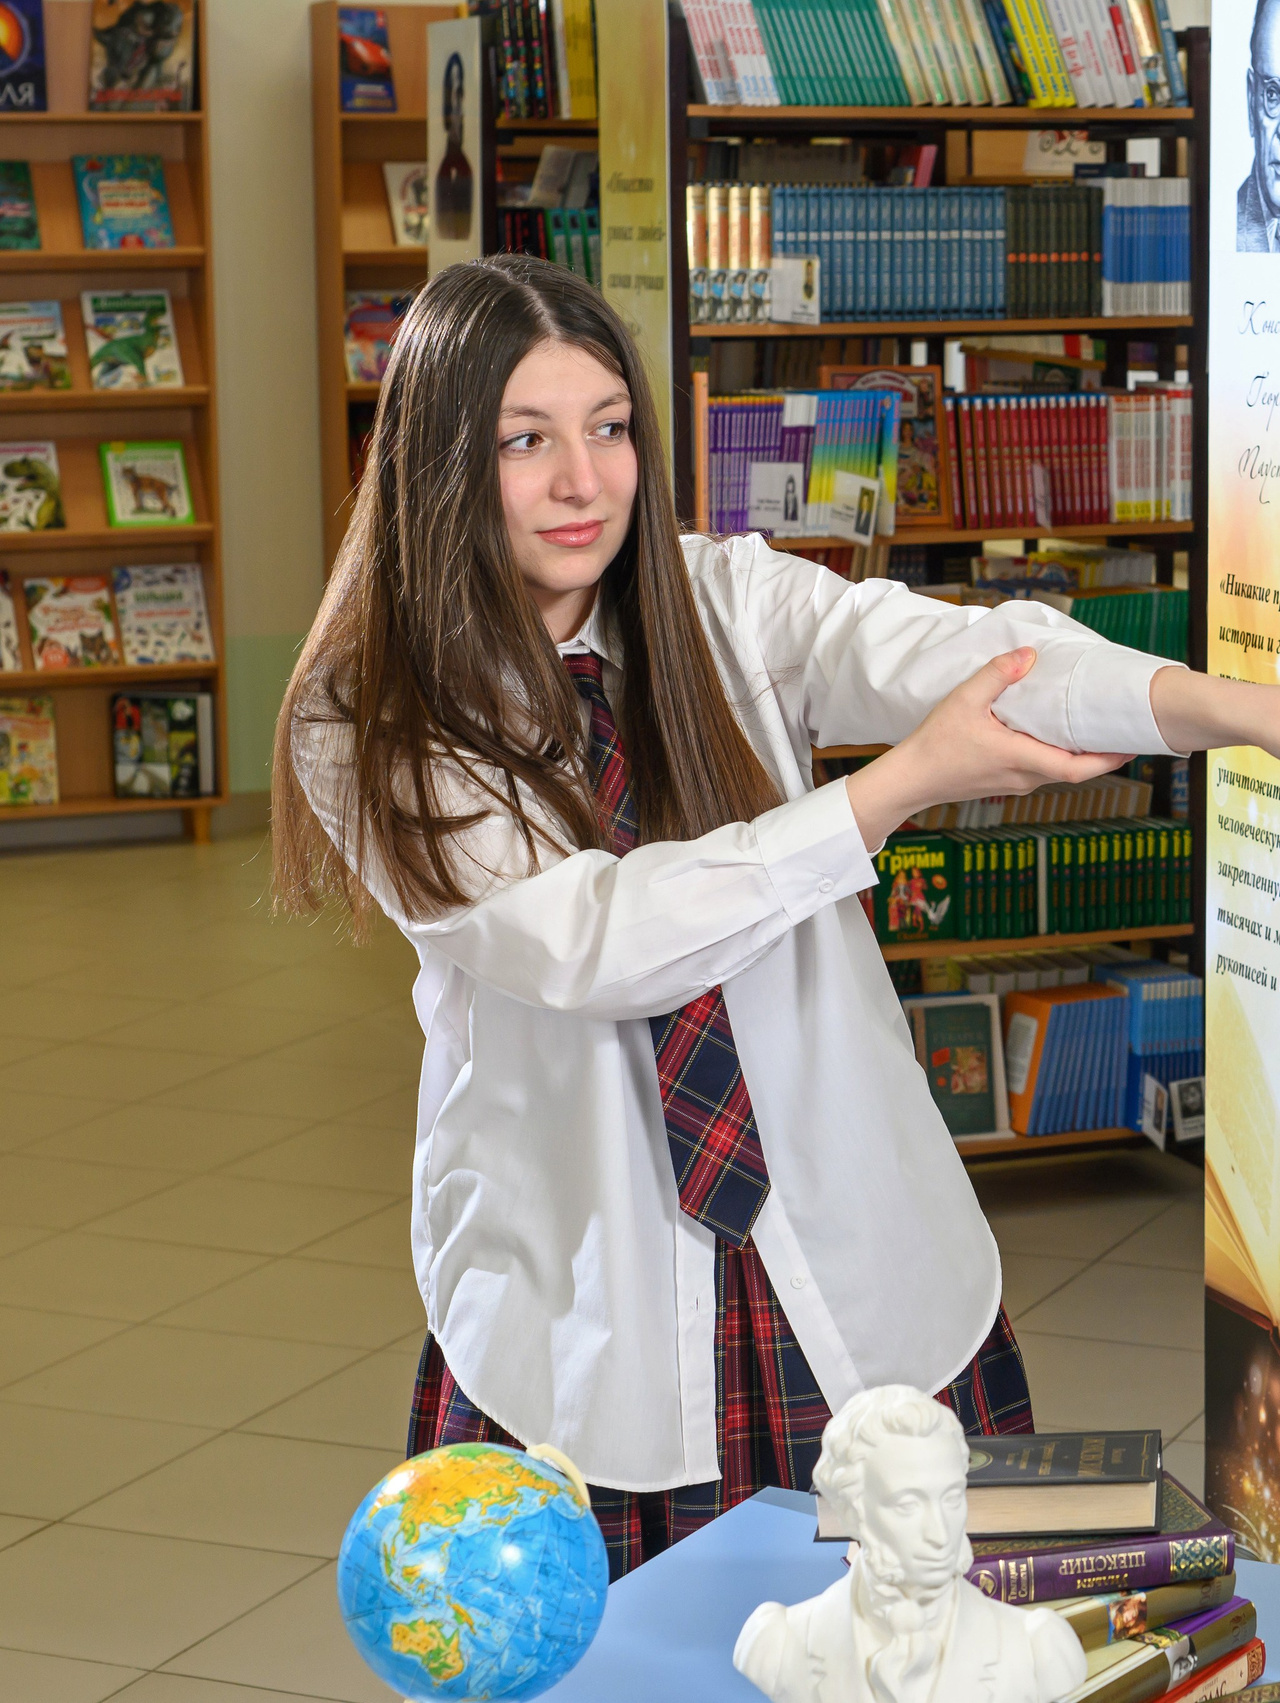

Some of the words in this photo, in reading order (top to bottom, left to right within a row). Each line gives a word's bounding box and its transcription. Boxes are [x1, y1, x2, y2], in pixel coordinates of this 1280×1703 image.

[1220, 573, 1270, 603] «Никакие
[1219, 625, 1264, 654] истории
[1267, 637, 1273, 652] и
[878, 850, 945, 875] Гримм
[1217, 906, 1263, 939] тысячах
[1265, 925, 1271, 941] и
[1216, 953, 1267, 987] рукописей
[1270, 974, 1277, 990] и
[1059, 1551, 1146, 1576] ШЕКСПИР
